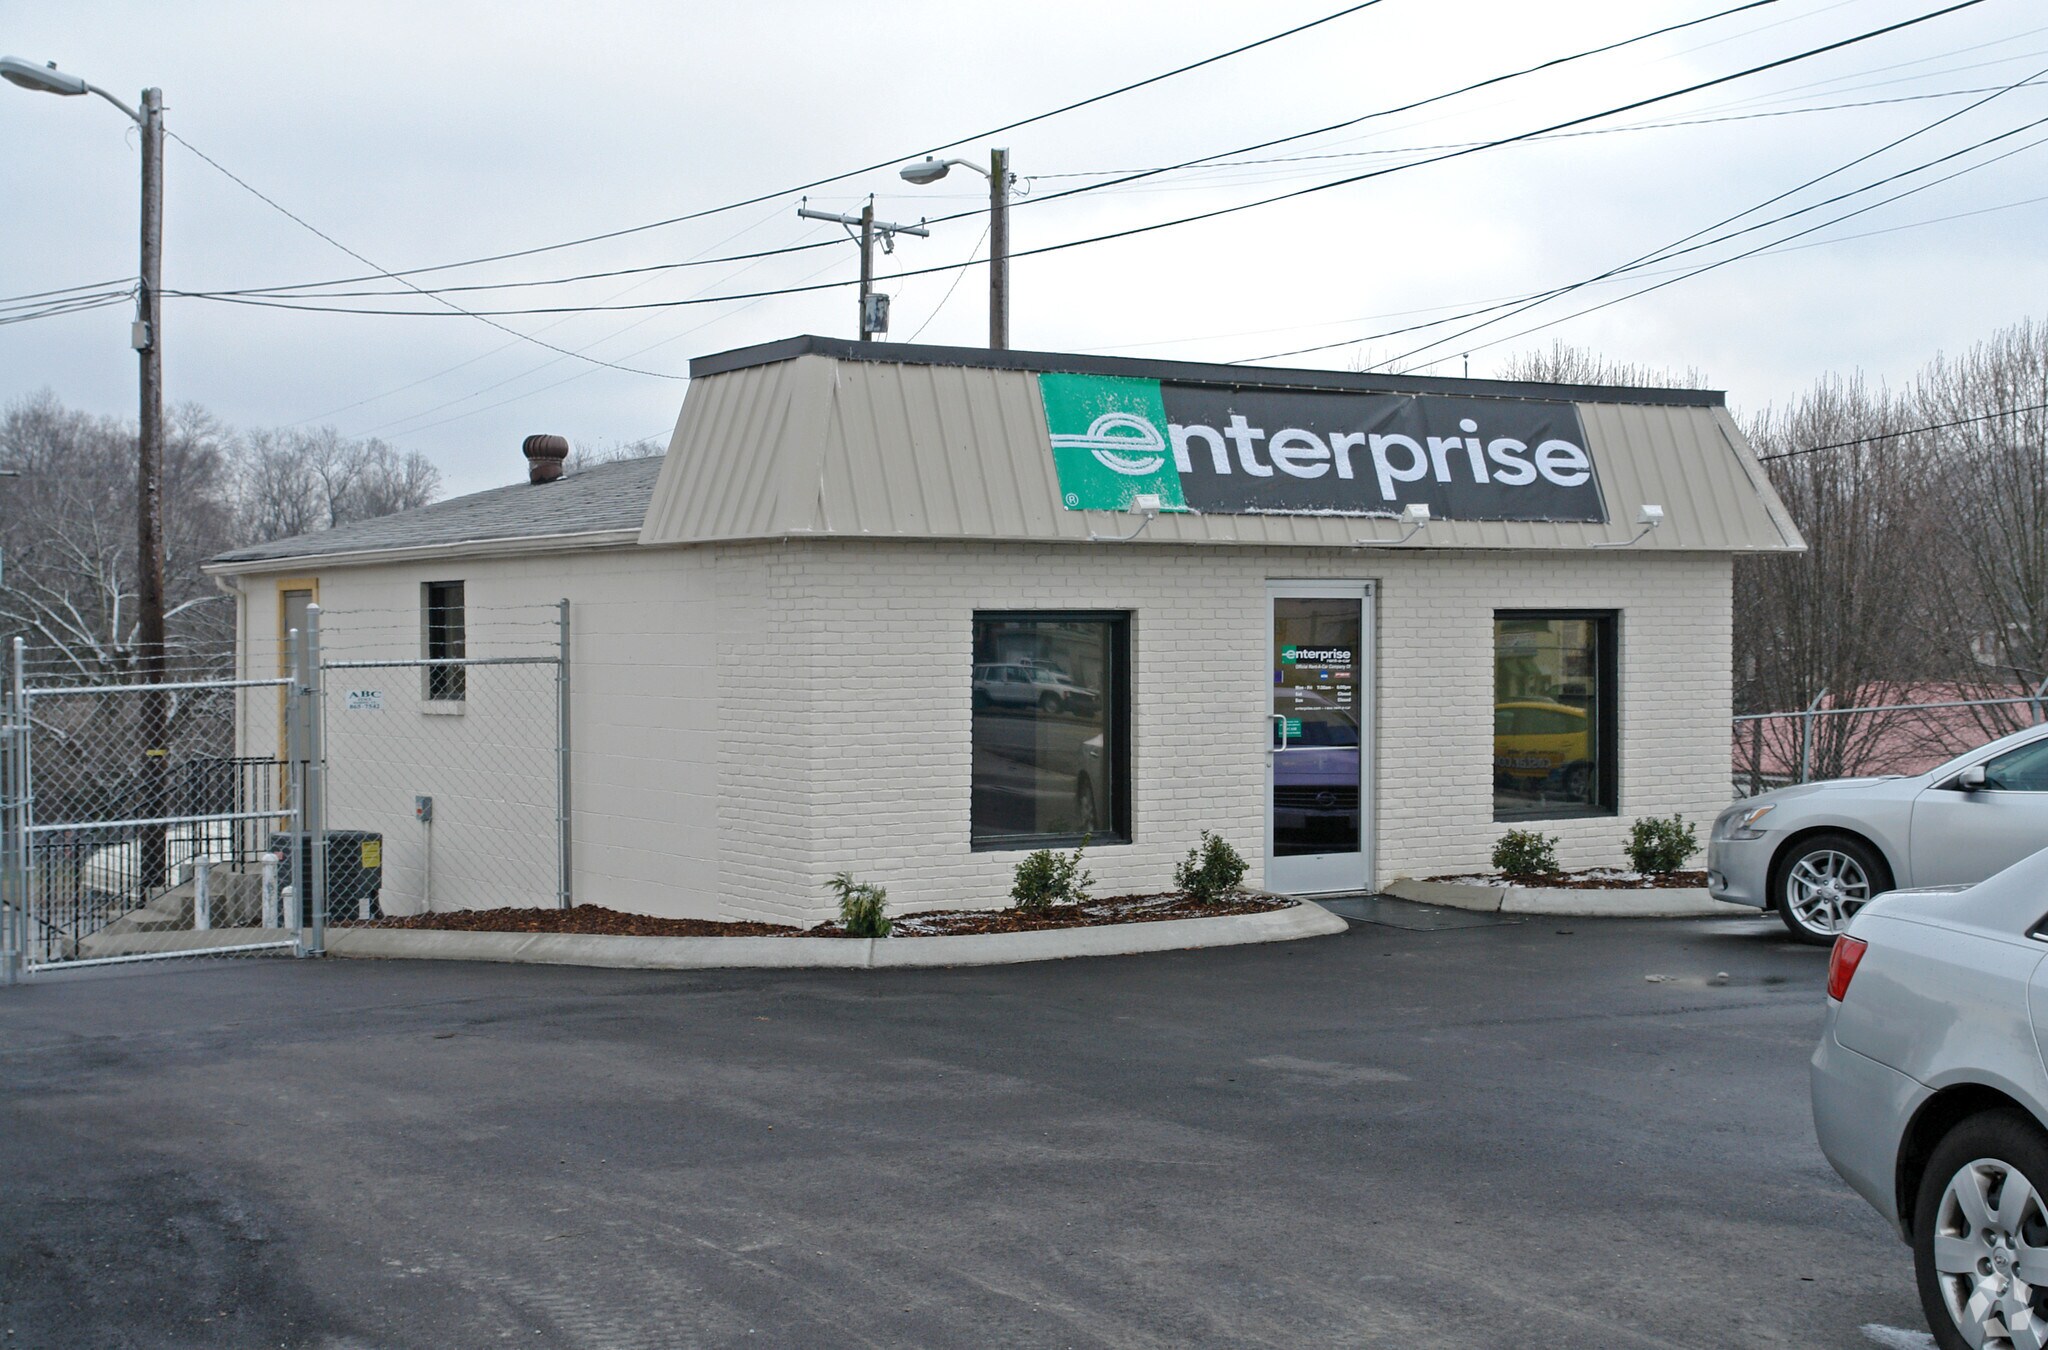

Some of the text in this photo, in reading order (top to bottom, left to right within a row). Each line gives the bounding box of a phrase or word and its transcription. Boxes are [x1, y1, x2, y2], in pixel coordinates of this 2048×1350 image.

[1050, 411, 1591, 501] enterprise
[1282, 649, 1351, 661] enterprise
[349, 691, 382, 699] ABC
